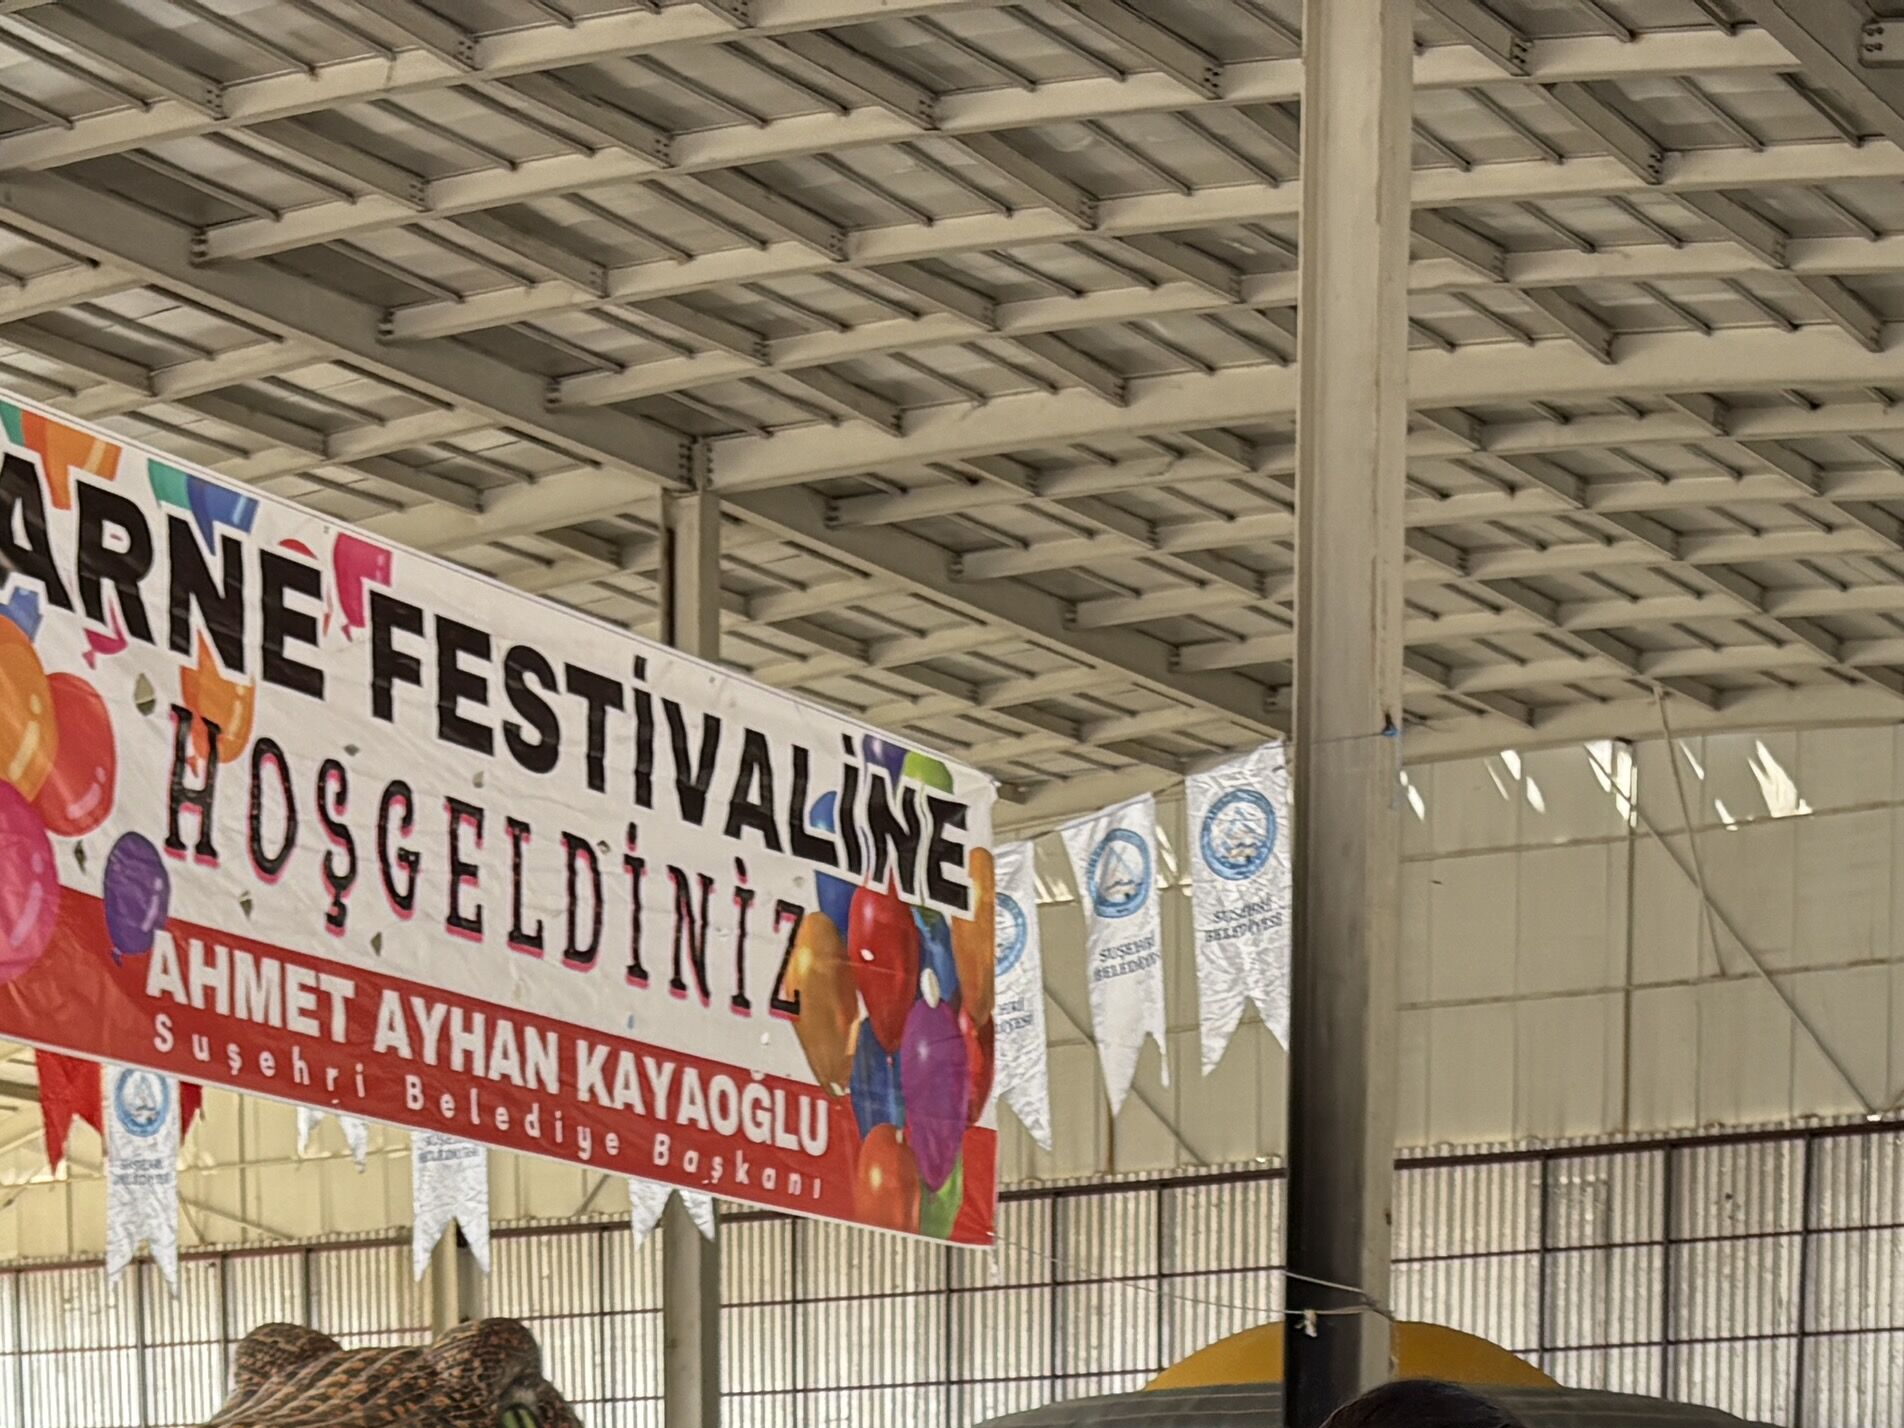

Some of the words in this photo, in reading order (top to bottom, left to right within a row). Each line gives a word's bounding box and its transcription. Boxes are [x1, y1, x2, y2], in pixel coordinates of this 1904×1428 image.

[163, 702, 805, 1020] HOŞGELDİNİZ
[369, 589, 971, 911] FESTİVALİNE
[146, 929, 356, 1044] AHMET
[373, 988, 560, 1095] AYHAN
[576, 1039, 829, 1157] KAYAOĞLU
[153, 1013, 366, 1099] Suşehri
[405, 1073, 620, 1161] Belediye
[652, 1132, 822, 1199] Başkanı
